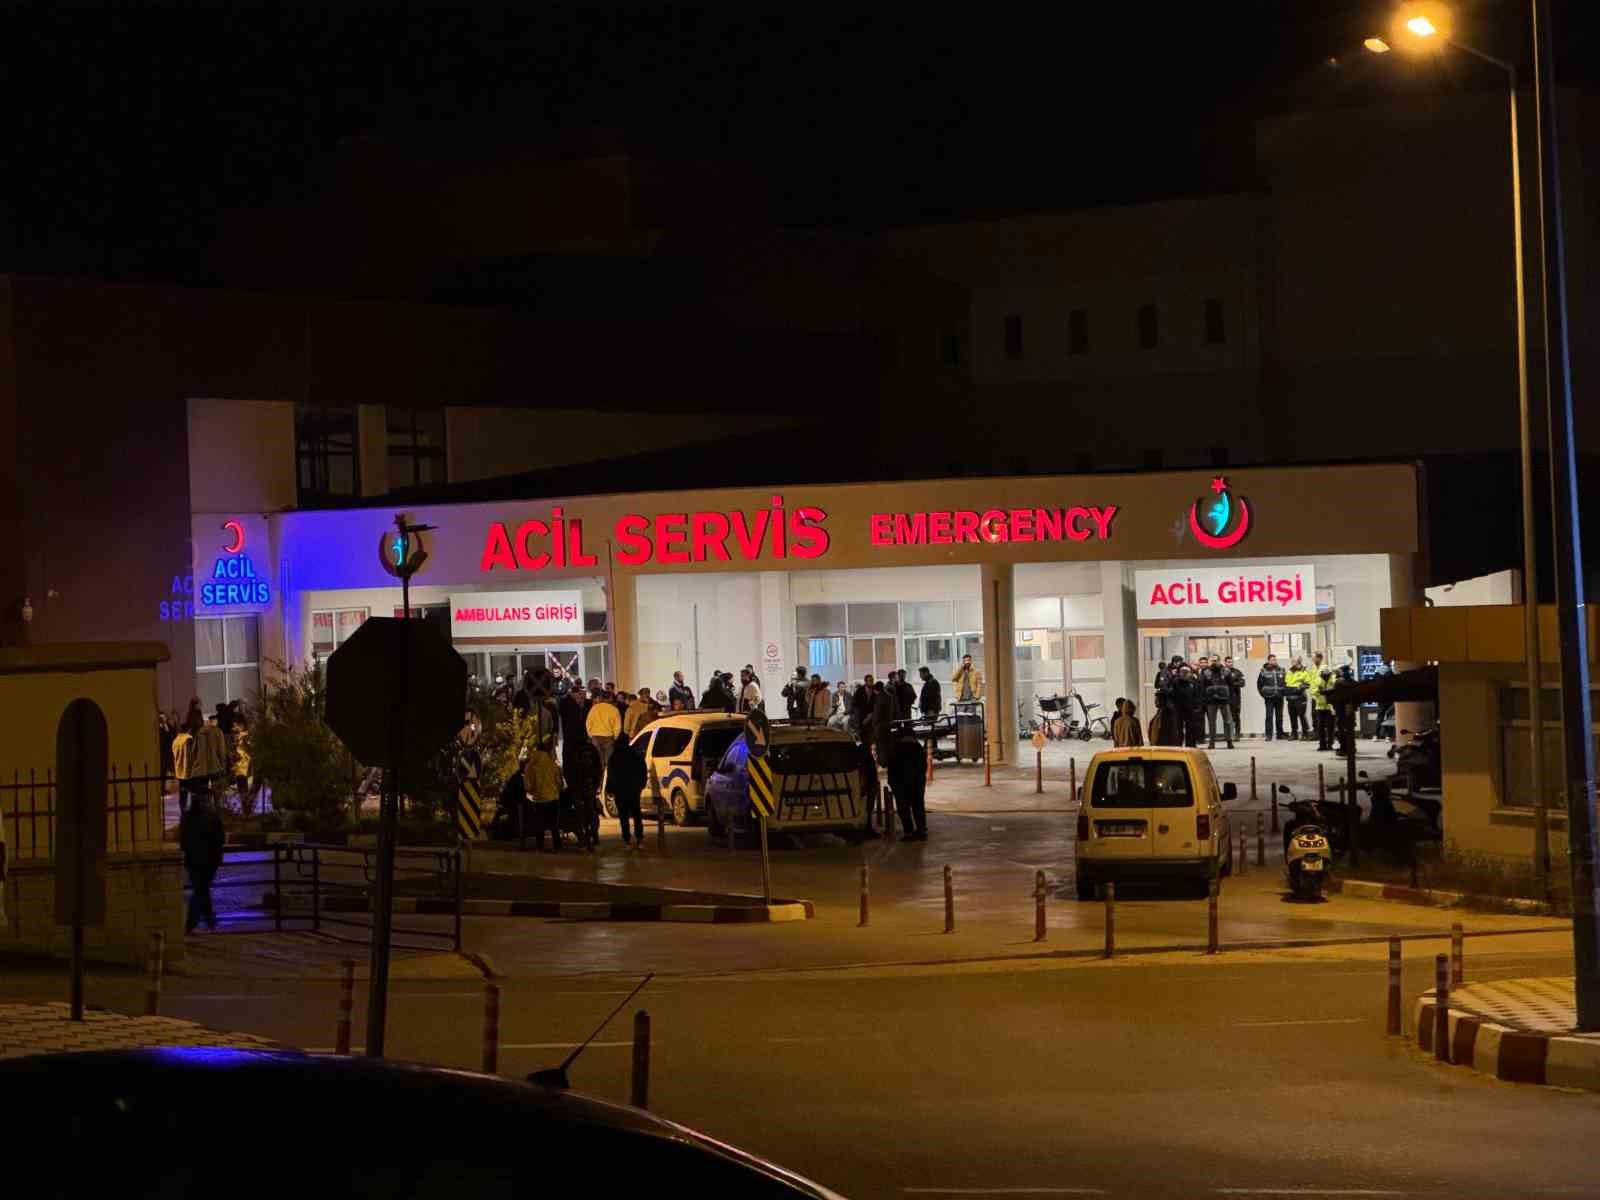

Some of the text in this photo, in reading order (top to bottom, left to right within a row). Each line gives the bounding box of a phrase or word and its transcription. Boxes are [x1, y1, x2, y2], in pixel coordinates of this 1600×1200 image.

[480, 496, 830, 571] ACİL SERVİS
[870, 505, 1118, 547] EMERGENCY
[213, 553, 256, 579] ACİL
[202, 579, 270, 605] SERVİS
[1150, 575, 1303, 606] ACİL GİRİŞİ
[454, 603, 577, 623] AMBULANS GİRİŞİ
